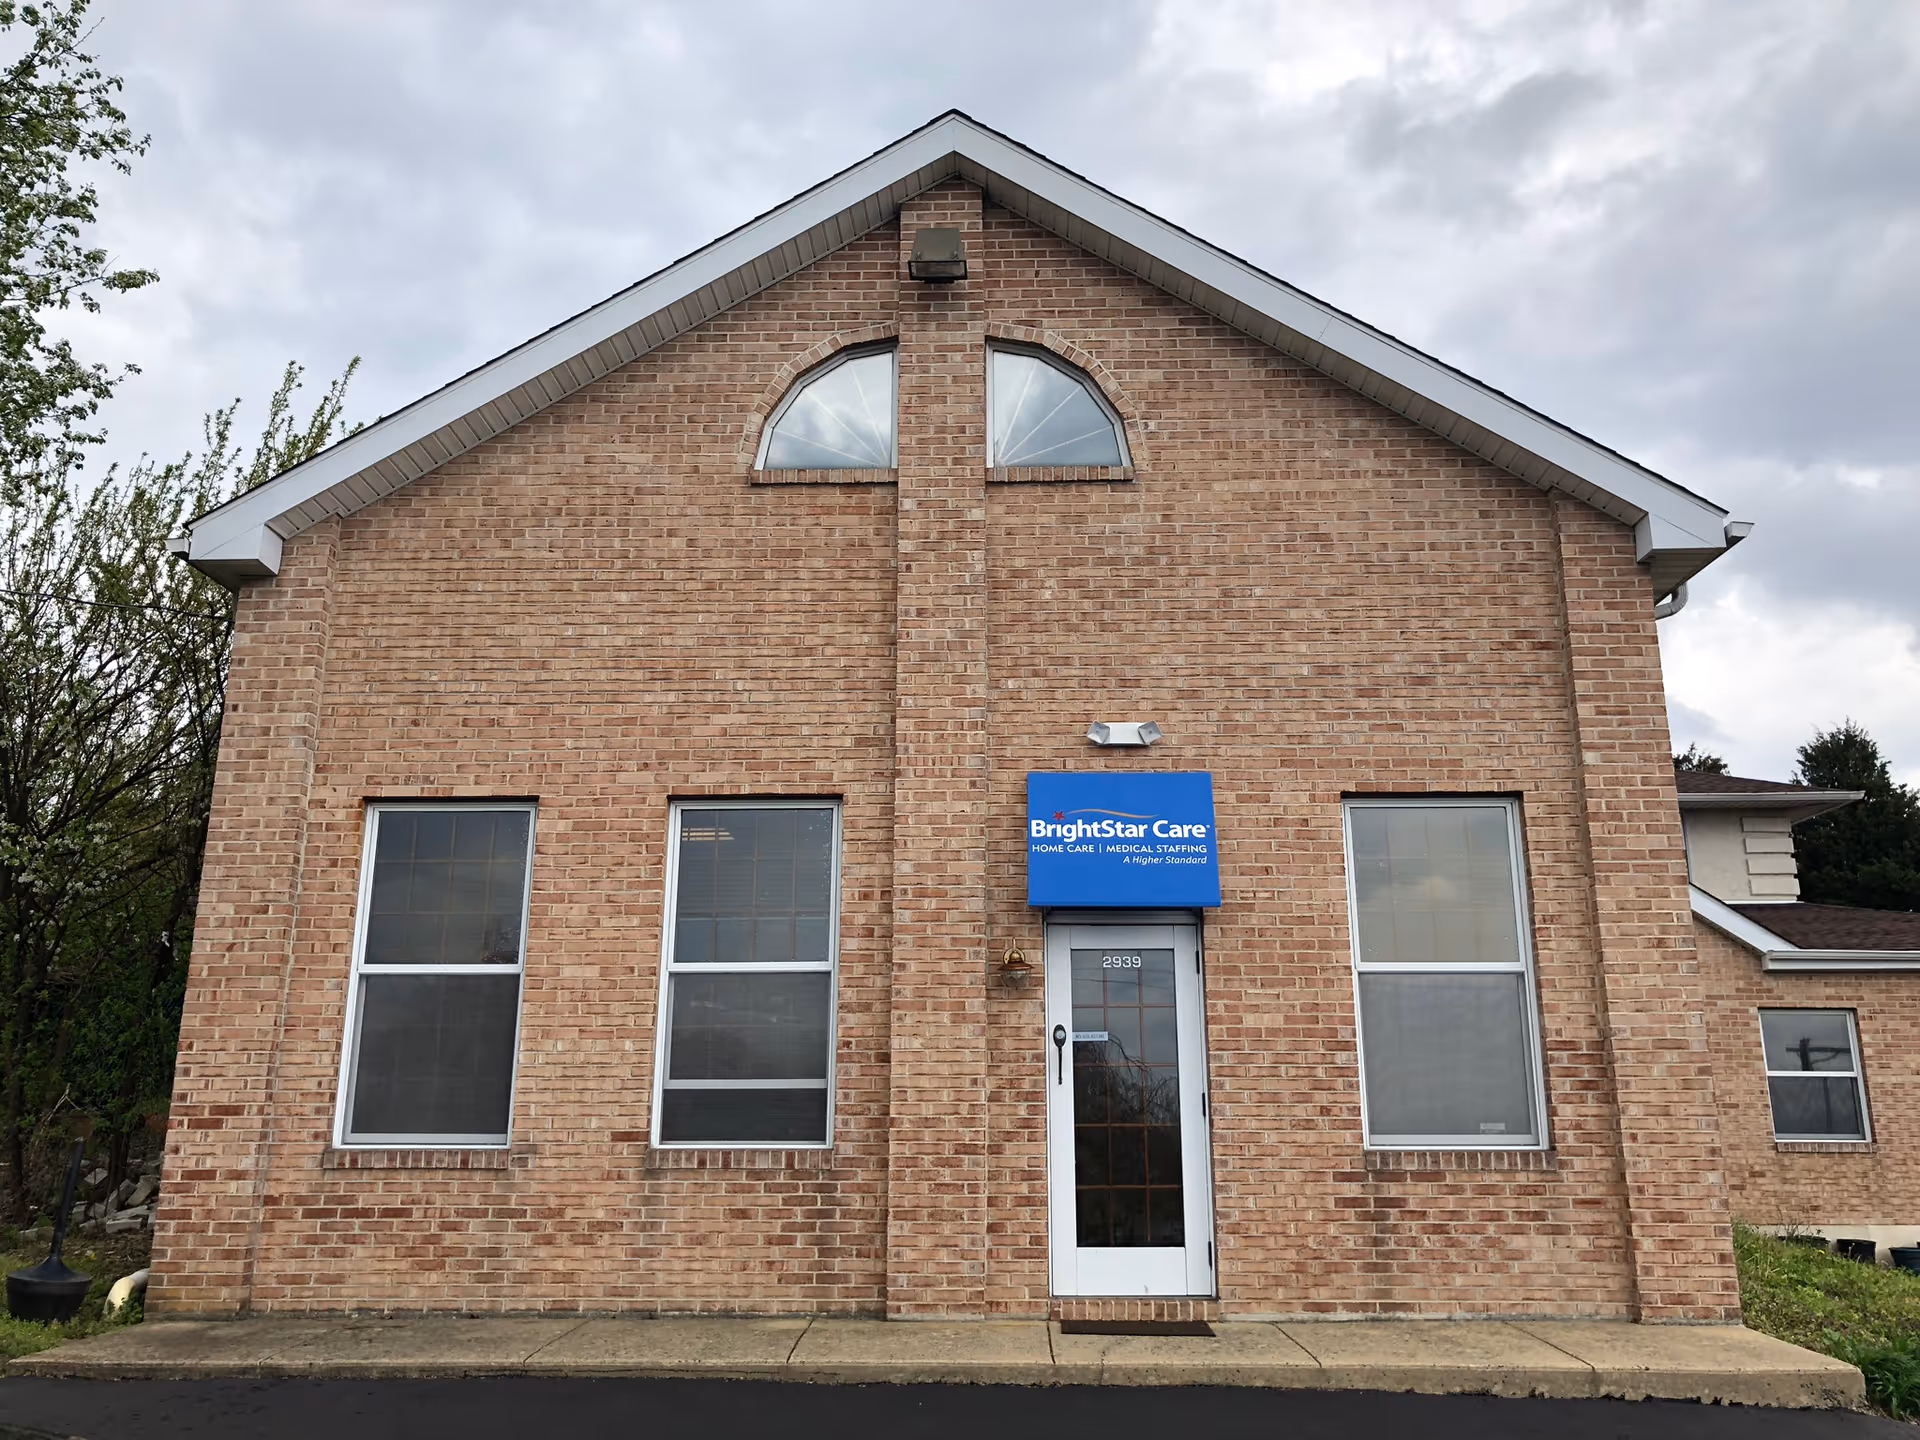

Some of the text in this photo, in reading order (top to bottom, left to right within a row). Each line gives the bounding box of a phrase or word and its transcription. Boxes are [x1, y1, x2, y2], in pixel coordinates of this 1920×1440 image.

[1031, 819, 1207, 842] BrightStar Care
[1032, 844, 1207, 853] HOME CARE MEDICAL STAFFING
[1123, 855, 1208, 866] A Higher Standard
[1102, 956, 1142, 968] 2939
